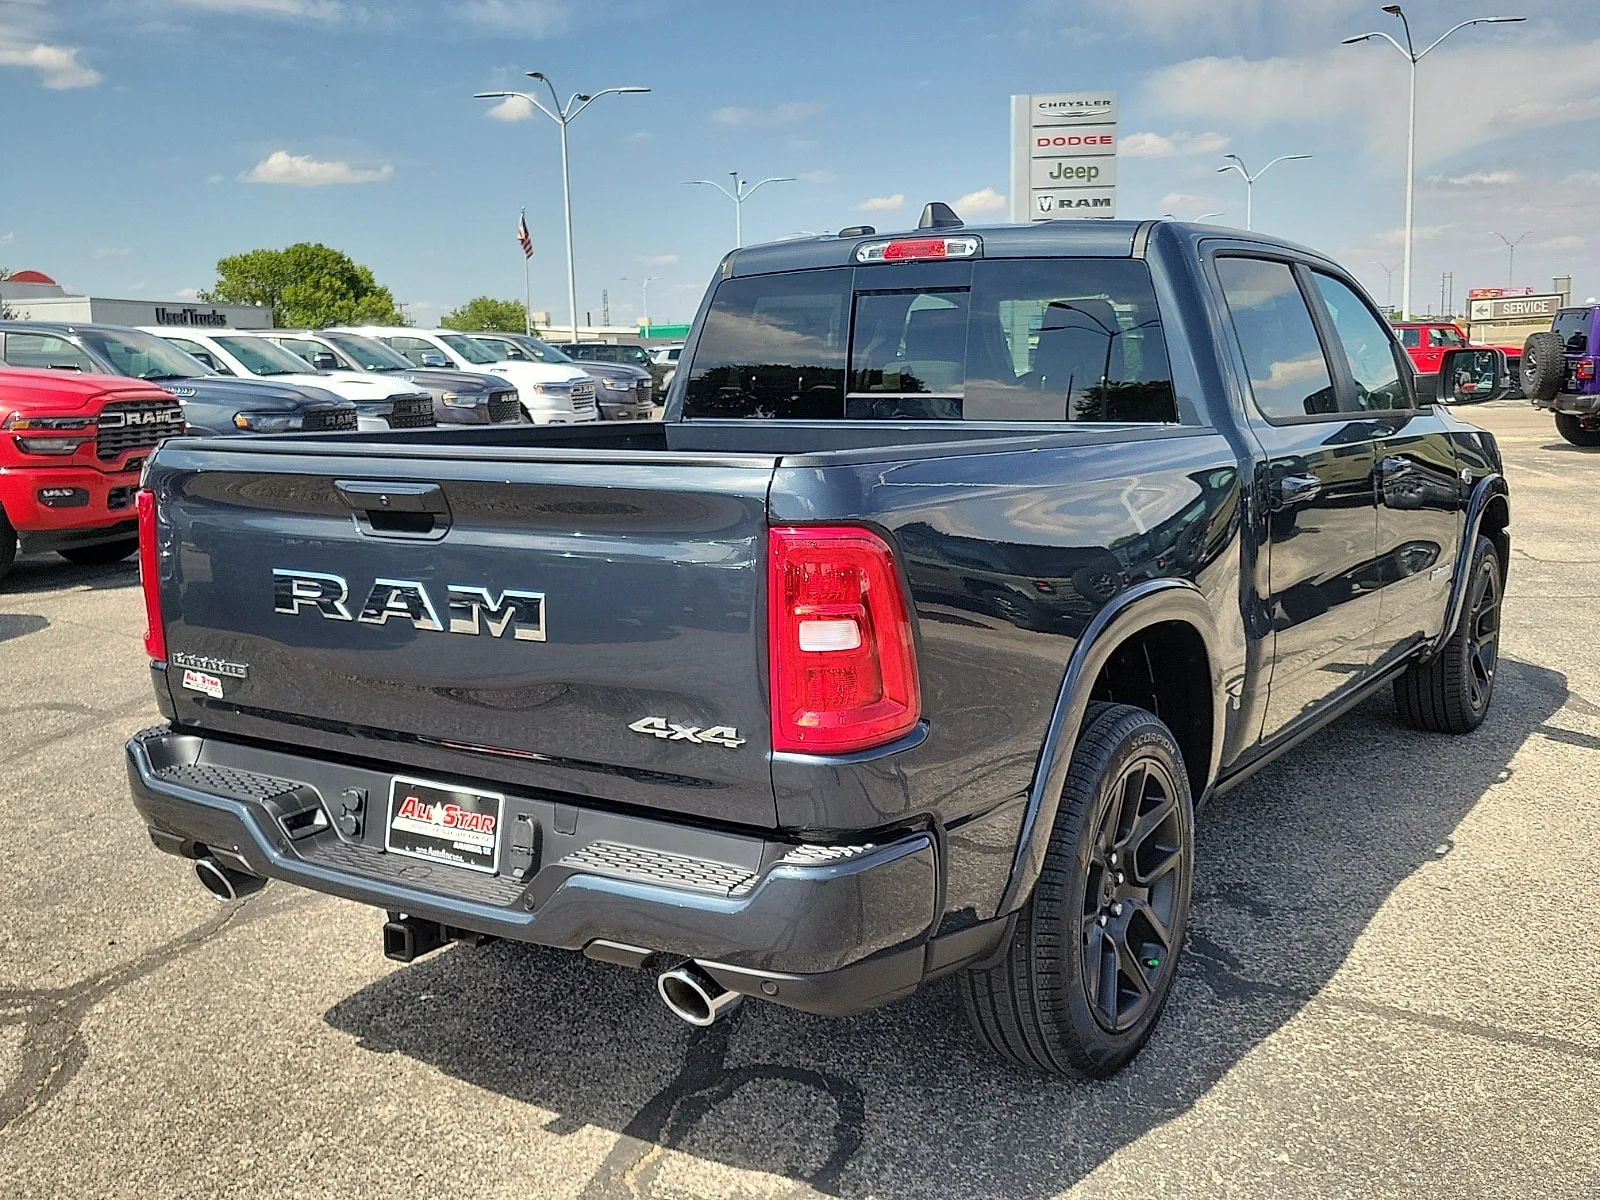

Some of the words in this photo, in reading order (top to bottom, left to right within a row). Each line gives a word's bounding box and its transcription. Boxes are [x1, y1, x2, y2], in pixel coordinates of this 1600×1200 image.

[1038, 100, 1111, 109] CHRYSLER
[1037, 135, 1113, 147] DODGE
[1048, 162, 1099, 183] Jeep
[1058, 198, 1111, 209] RAM
[1502, 301, 1549, 315] SERVICE
[155, 307, 188, 325] Used
[187, 308, 227, 327] Trucks
[126, 409, 171, 426] RAM
[325, 412, 353, 427] RAM
[272, 568, 547, 643] RAM
[1131, 732, 1175, 755] SCORPION
